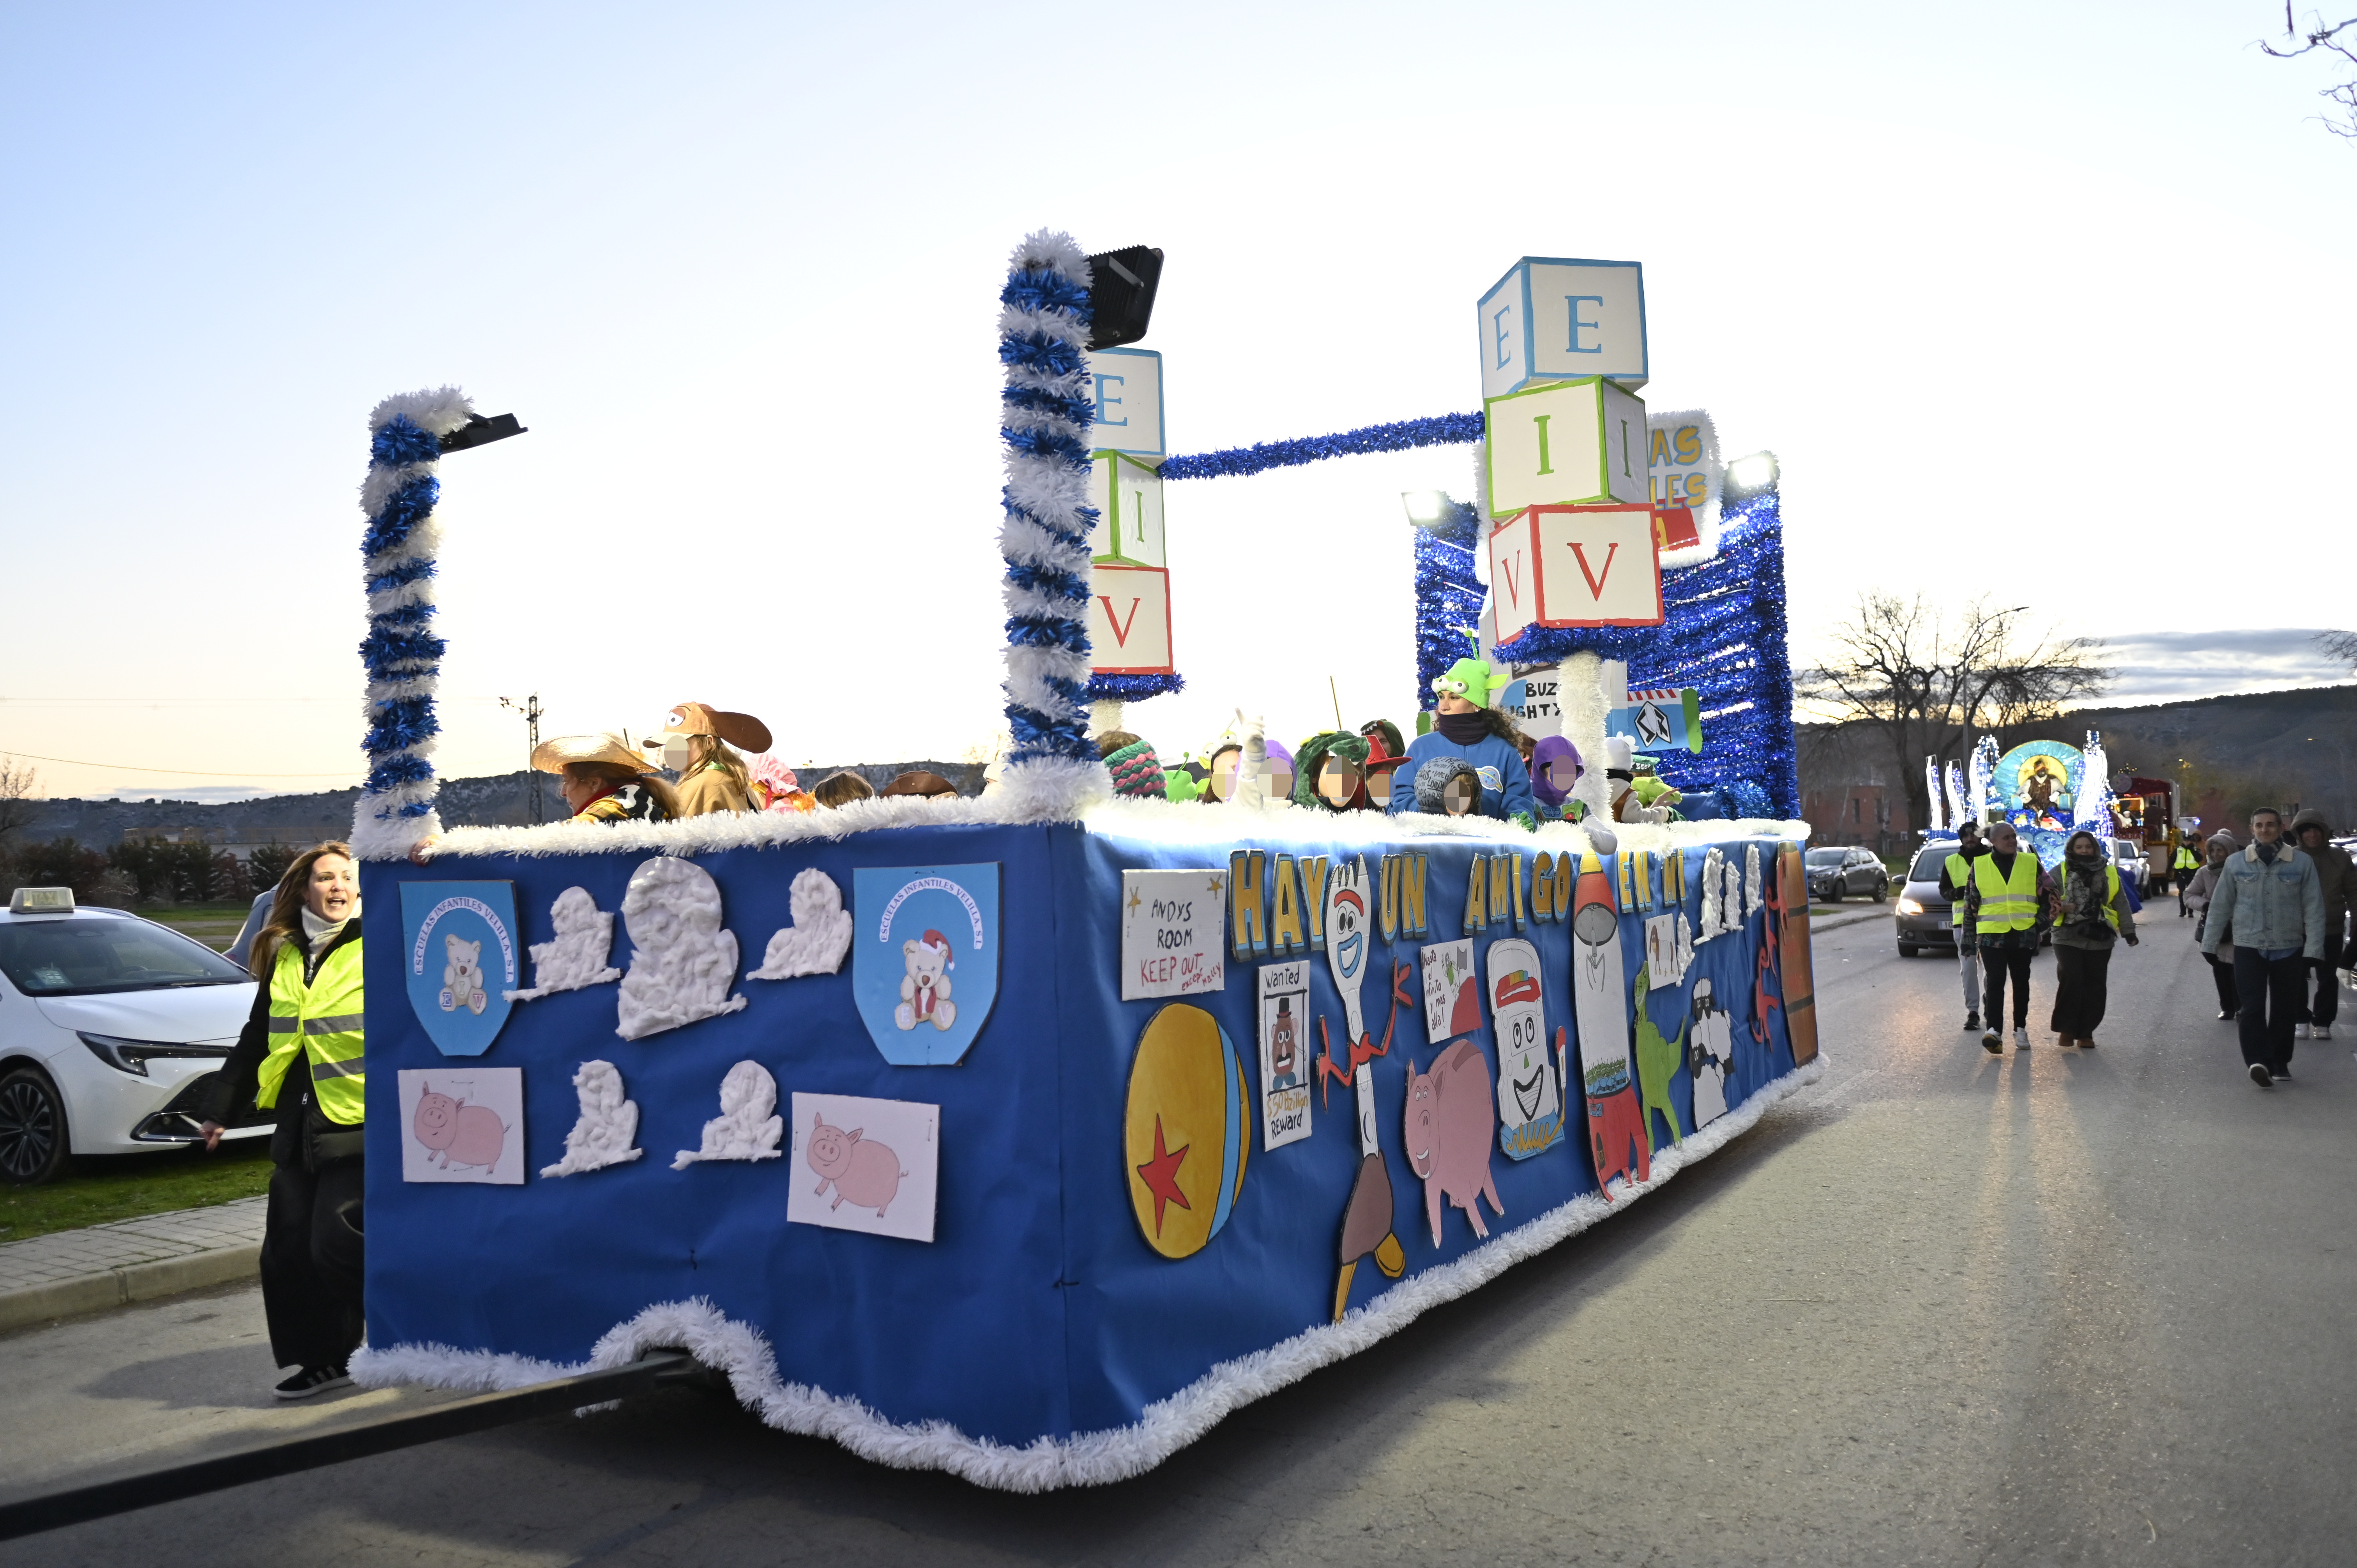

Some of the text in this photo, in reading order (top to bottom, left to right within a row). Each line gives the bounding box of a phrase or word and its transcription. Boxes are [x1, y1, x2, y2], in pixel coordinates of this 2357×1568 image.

[1493, 305, 1511, 371] E
[1564, 295, 1603, 354] E
[1092, 373, 1127, 427] E
[1534, 415, 1555, 476] I
[1620, 418, 1631, 478] I
[1649, 426, 1703, 468] AS
[1135, 491, 1145, 542] I
[1650, 472, 1707, 511] LES
[1502, 549, 1520, 612] V
[1566, 542, 1618, 602] V
[1096, 595, 1141, 648] V
[1525, 682, 1559, 697] BUZ
[1434, 770, 1450, 780] BARCEL
[880, 893, 904, 941] ESCUELAS
[905, 879, 955, 895] INFANTILES
[1151, 898, 1193, 923] ANDYS
[1229, 848, 1687, 962] HAY UN AMIGO EN MI
[415, 915, 436, 975] ESCUELAS
[435, 897, 483, 917] INFANTILES
[1157, 928, 1193, 949] ROOM
[1141, 952, 1204, 987] KEEP OUT
[1265, 963, 1299, 989] Wanted
[442, 992, 452, 1007] E
